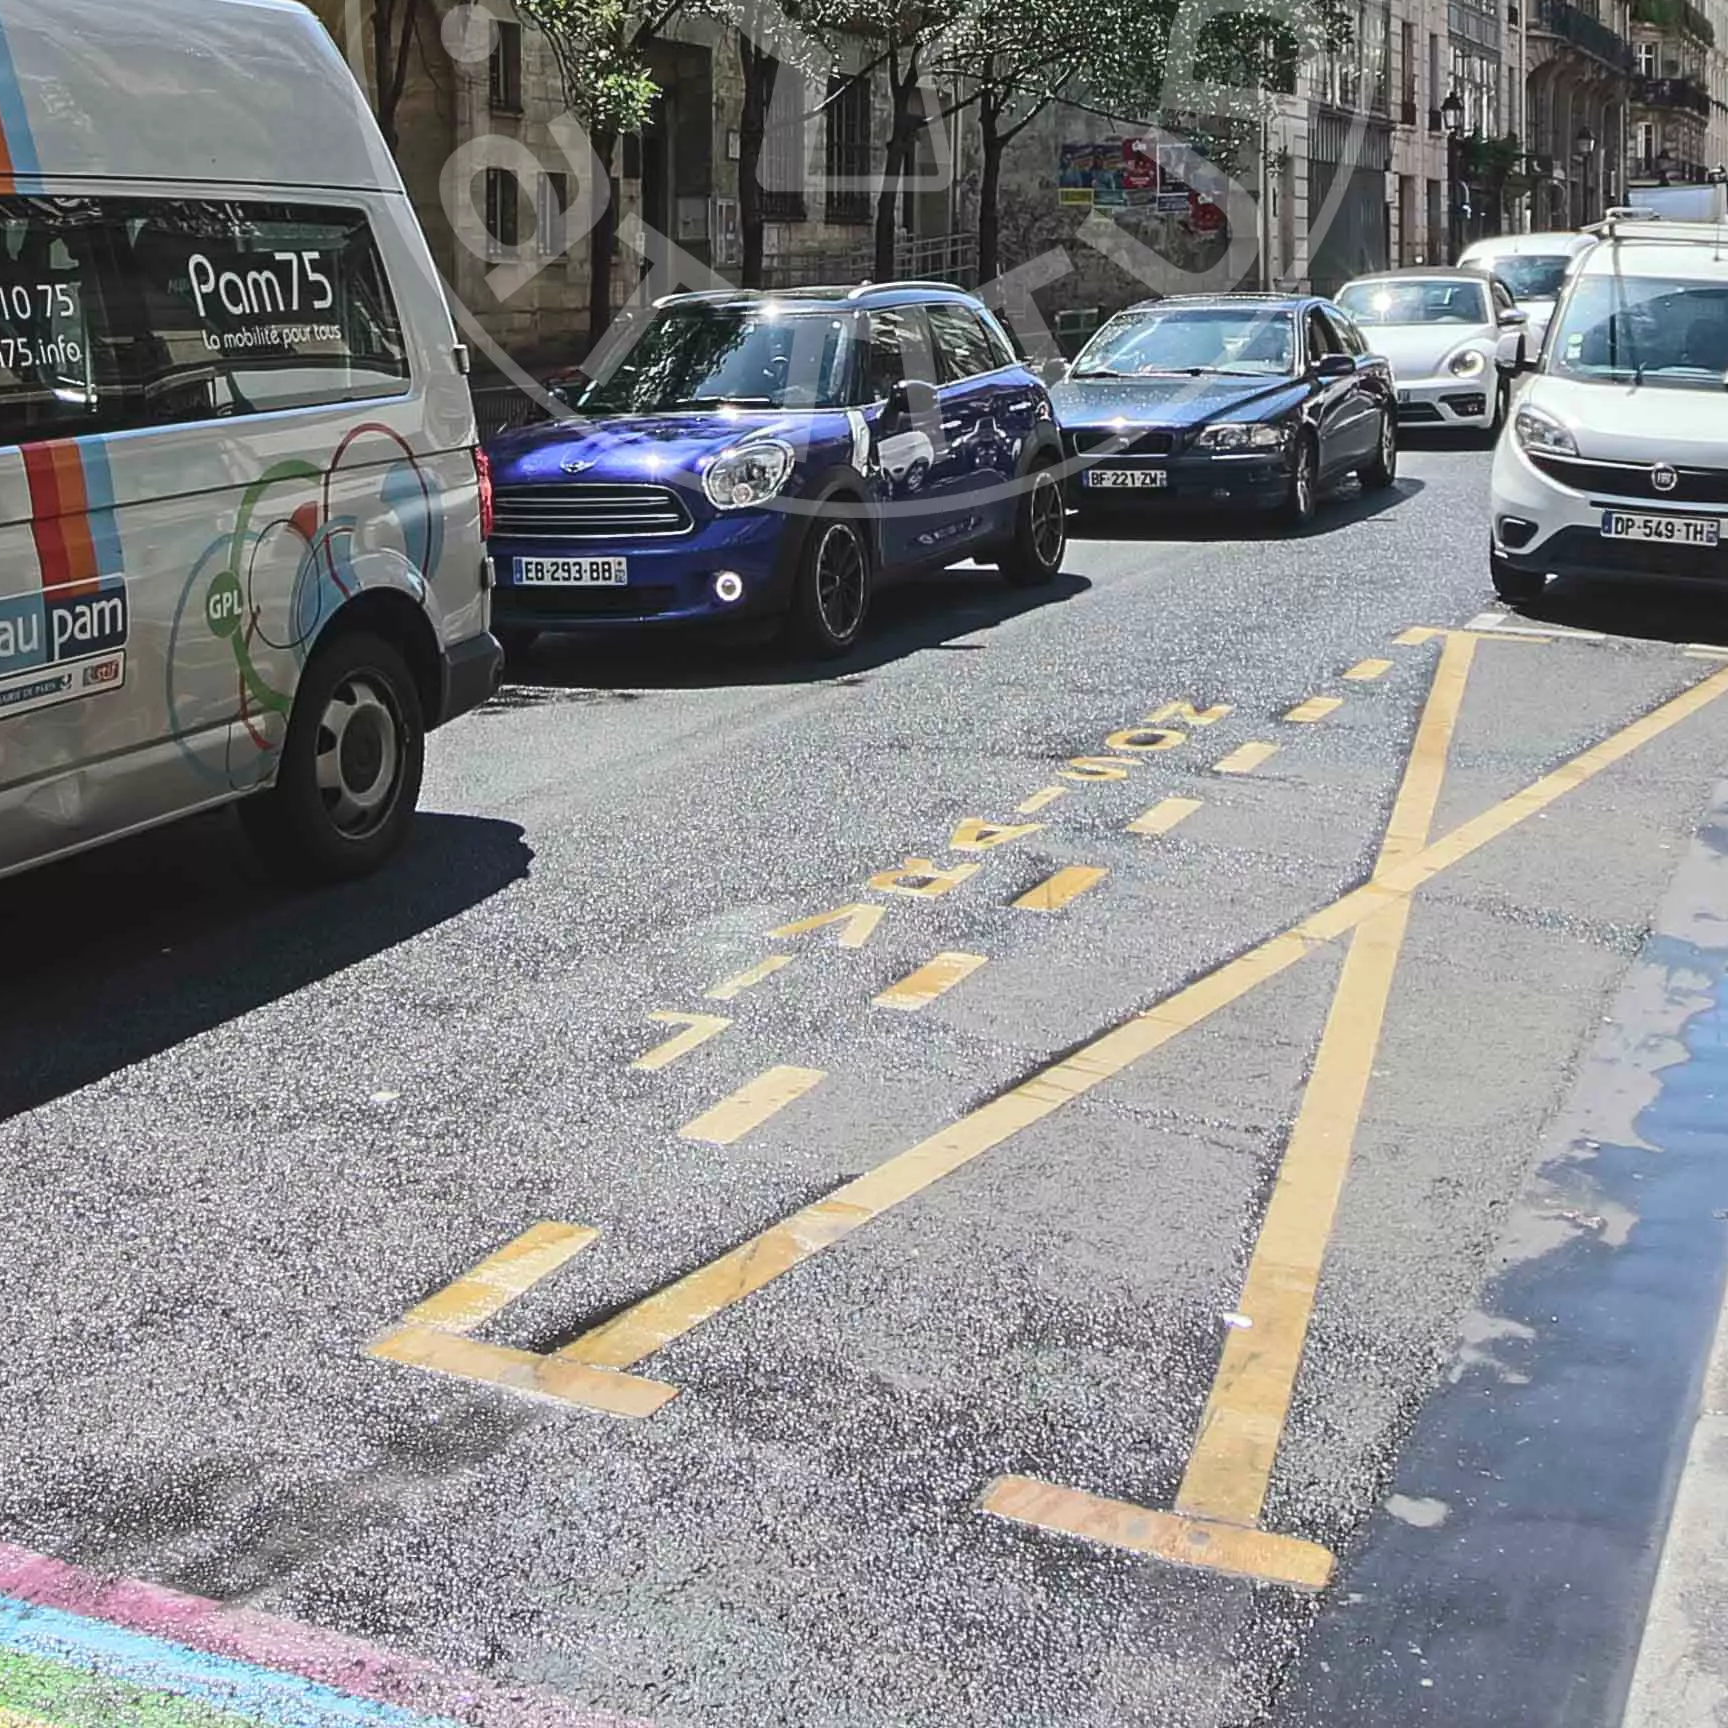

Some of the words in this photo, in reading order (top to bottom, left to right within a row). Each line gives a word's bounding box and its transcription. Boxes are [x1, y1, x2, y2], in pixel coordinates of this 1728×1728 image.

[187, 250, 333, 317] Pam75
[36, 283, 75, 317] 75
[201, 329, 221, 350] La
[223, 325, 280, 349] mobilité
[282, 326, 312, 350] pour
[312, 323, 342, 341] tous
[1614, 516, 1705, 542] DP-549-TH
[524, 560, 613, 582] EB-293-BB
[209, 589, 243, 620] GPL
[52, 597, 123, 661] pam
[630, 700, 1232, 1072] LIVRAISON
